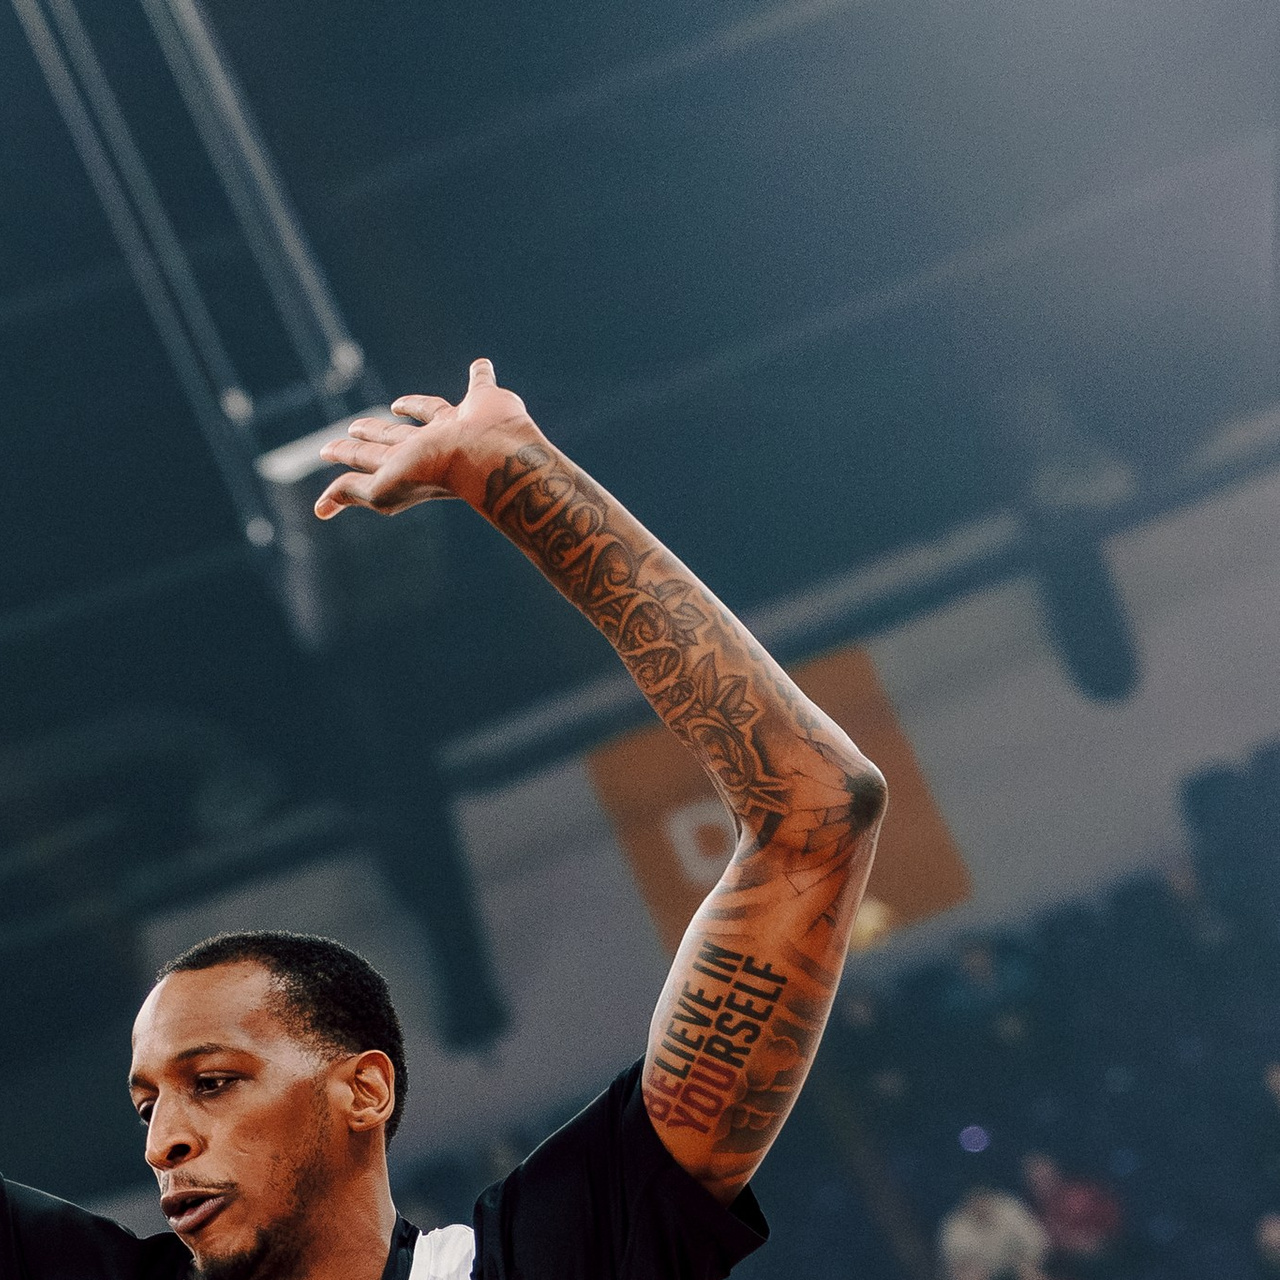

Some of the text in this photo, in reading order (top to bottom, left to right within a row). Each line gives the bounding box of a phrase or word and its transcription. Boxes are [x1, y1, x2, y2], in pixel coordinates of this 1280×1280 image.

[644, 941, 743, 1122] BELIEVE IN
[667, 955, 788, 1134] YOURSELF
